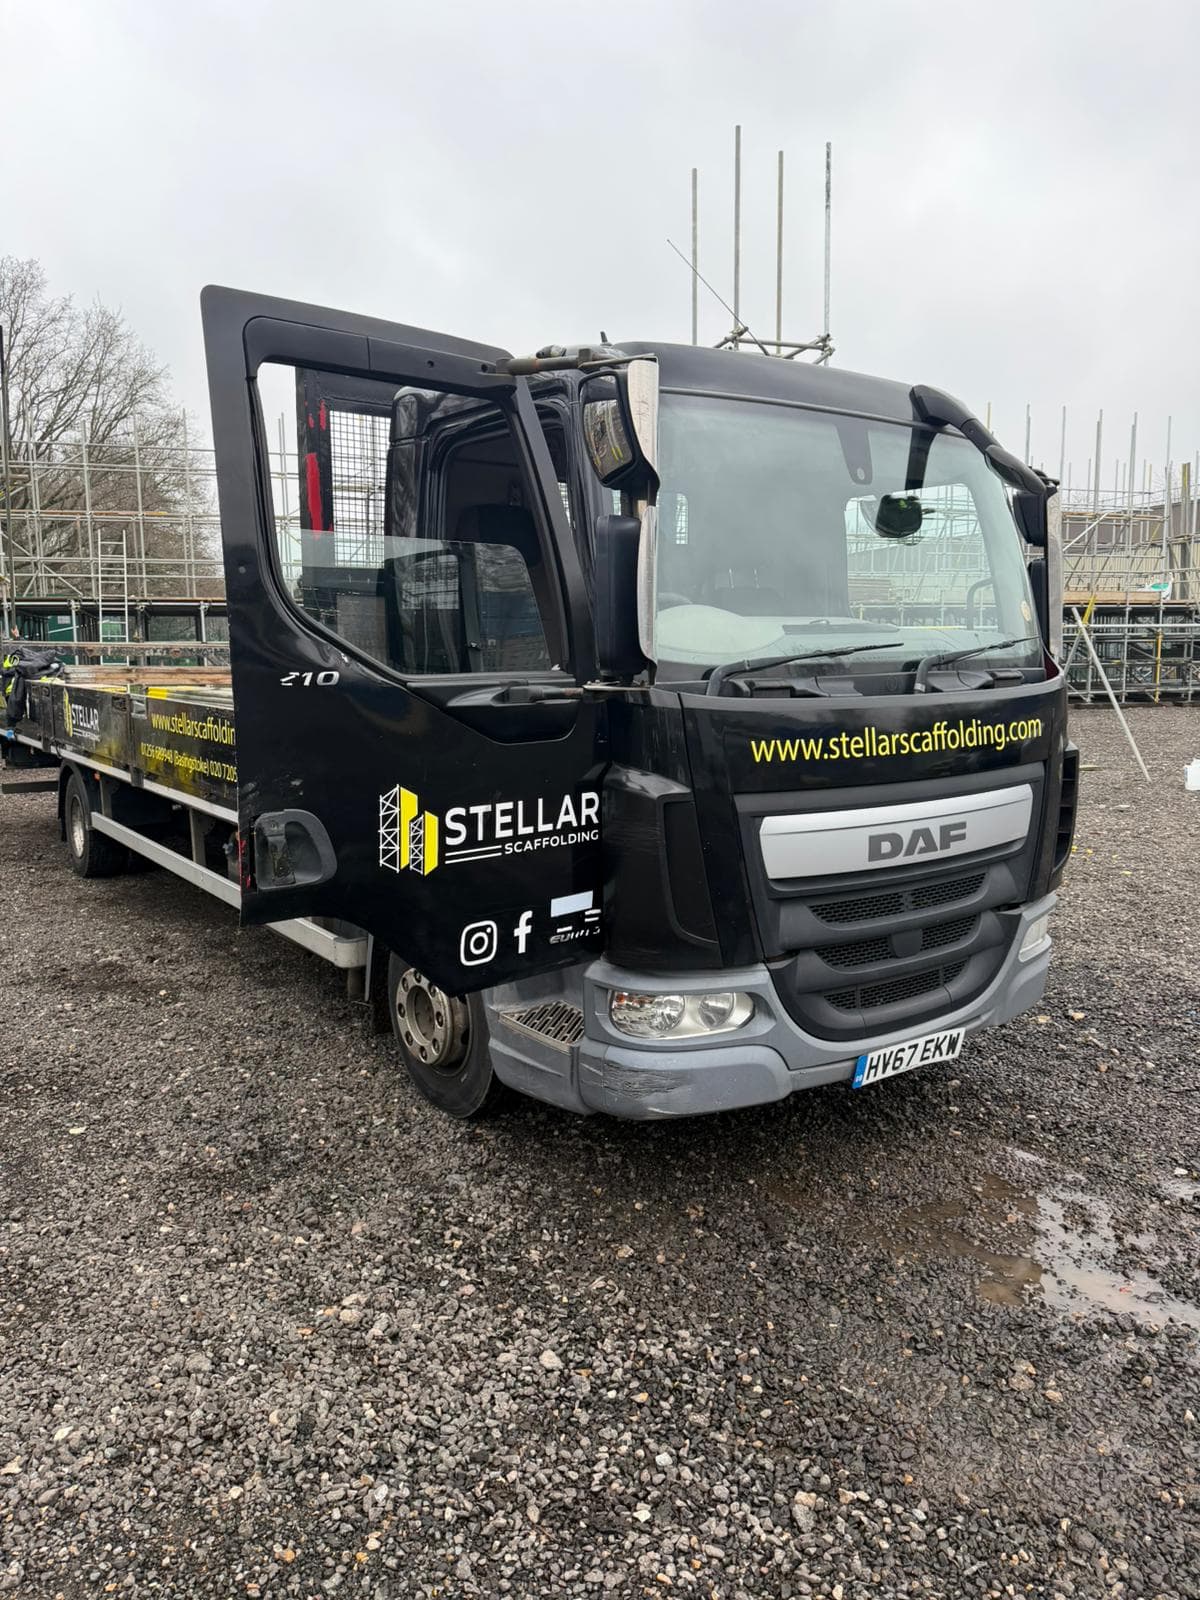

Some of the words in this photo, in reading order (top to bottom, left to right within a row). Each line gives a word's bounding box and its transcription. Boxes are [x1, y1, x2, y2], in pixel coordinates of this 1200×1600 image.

[280, 671, 340, 687] 210
[71, 703, 100, 732] STELLAR
[751, 718, 1043, 763] www.stellarscaffolding.com
[209, 760, 222, 778] 020
[444, 791, 600, 846] STELLAR
[504, 829, 600, 855] SCAFFOLDING
[867, 821, 967, 863] DAF
[866, 1043, 919, 1081] HV67
[920, 1032, 961, 1062] EKW
